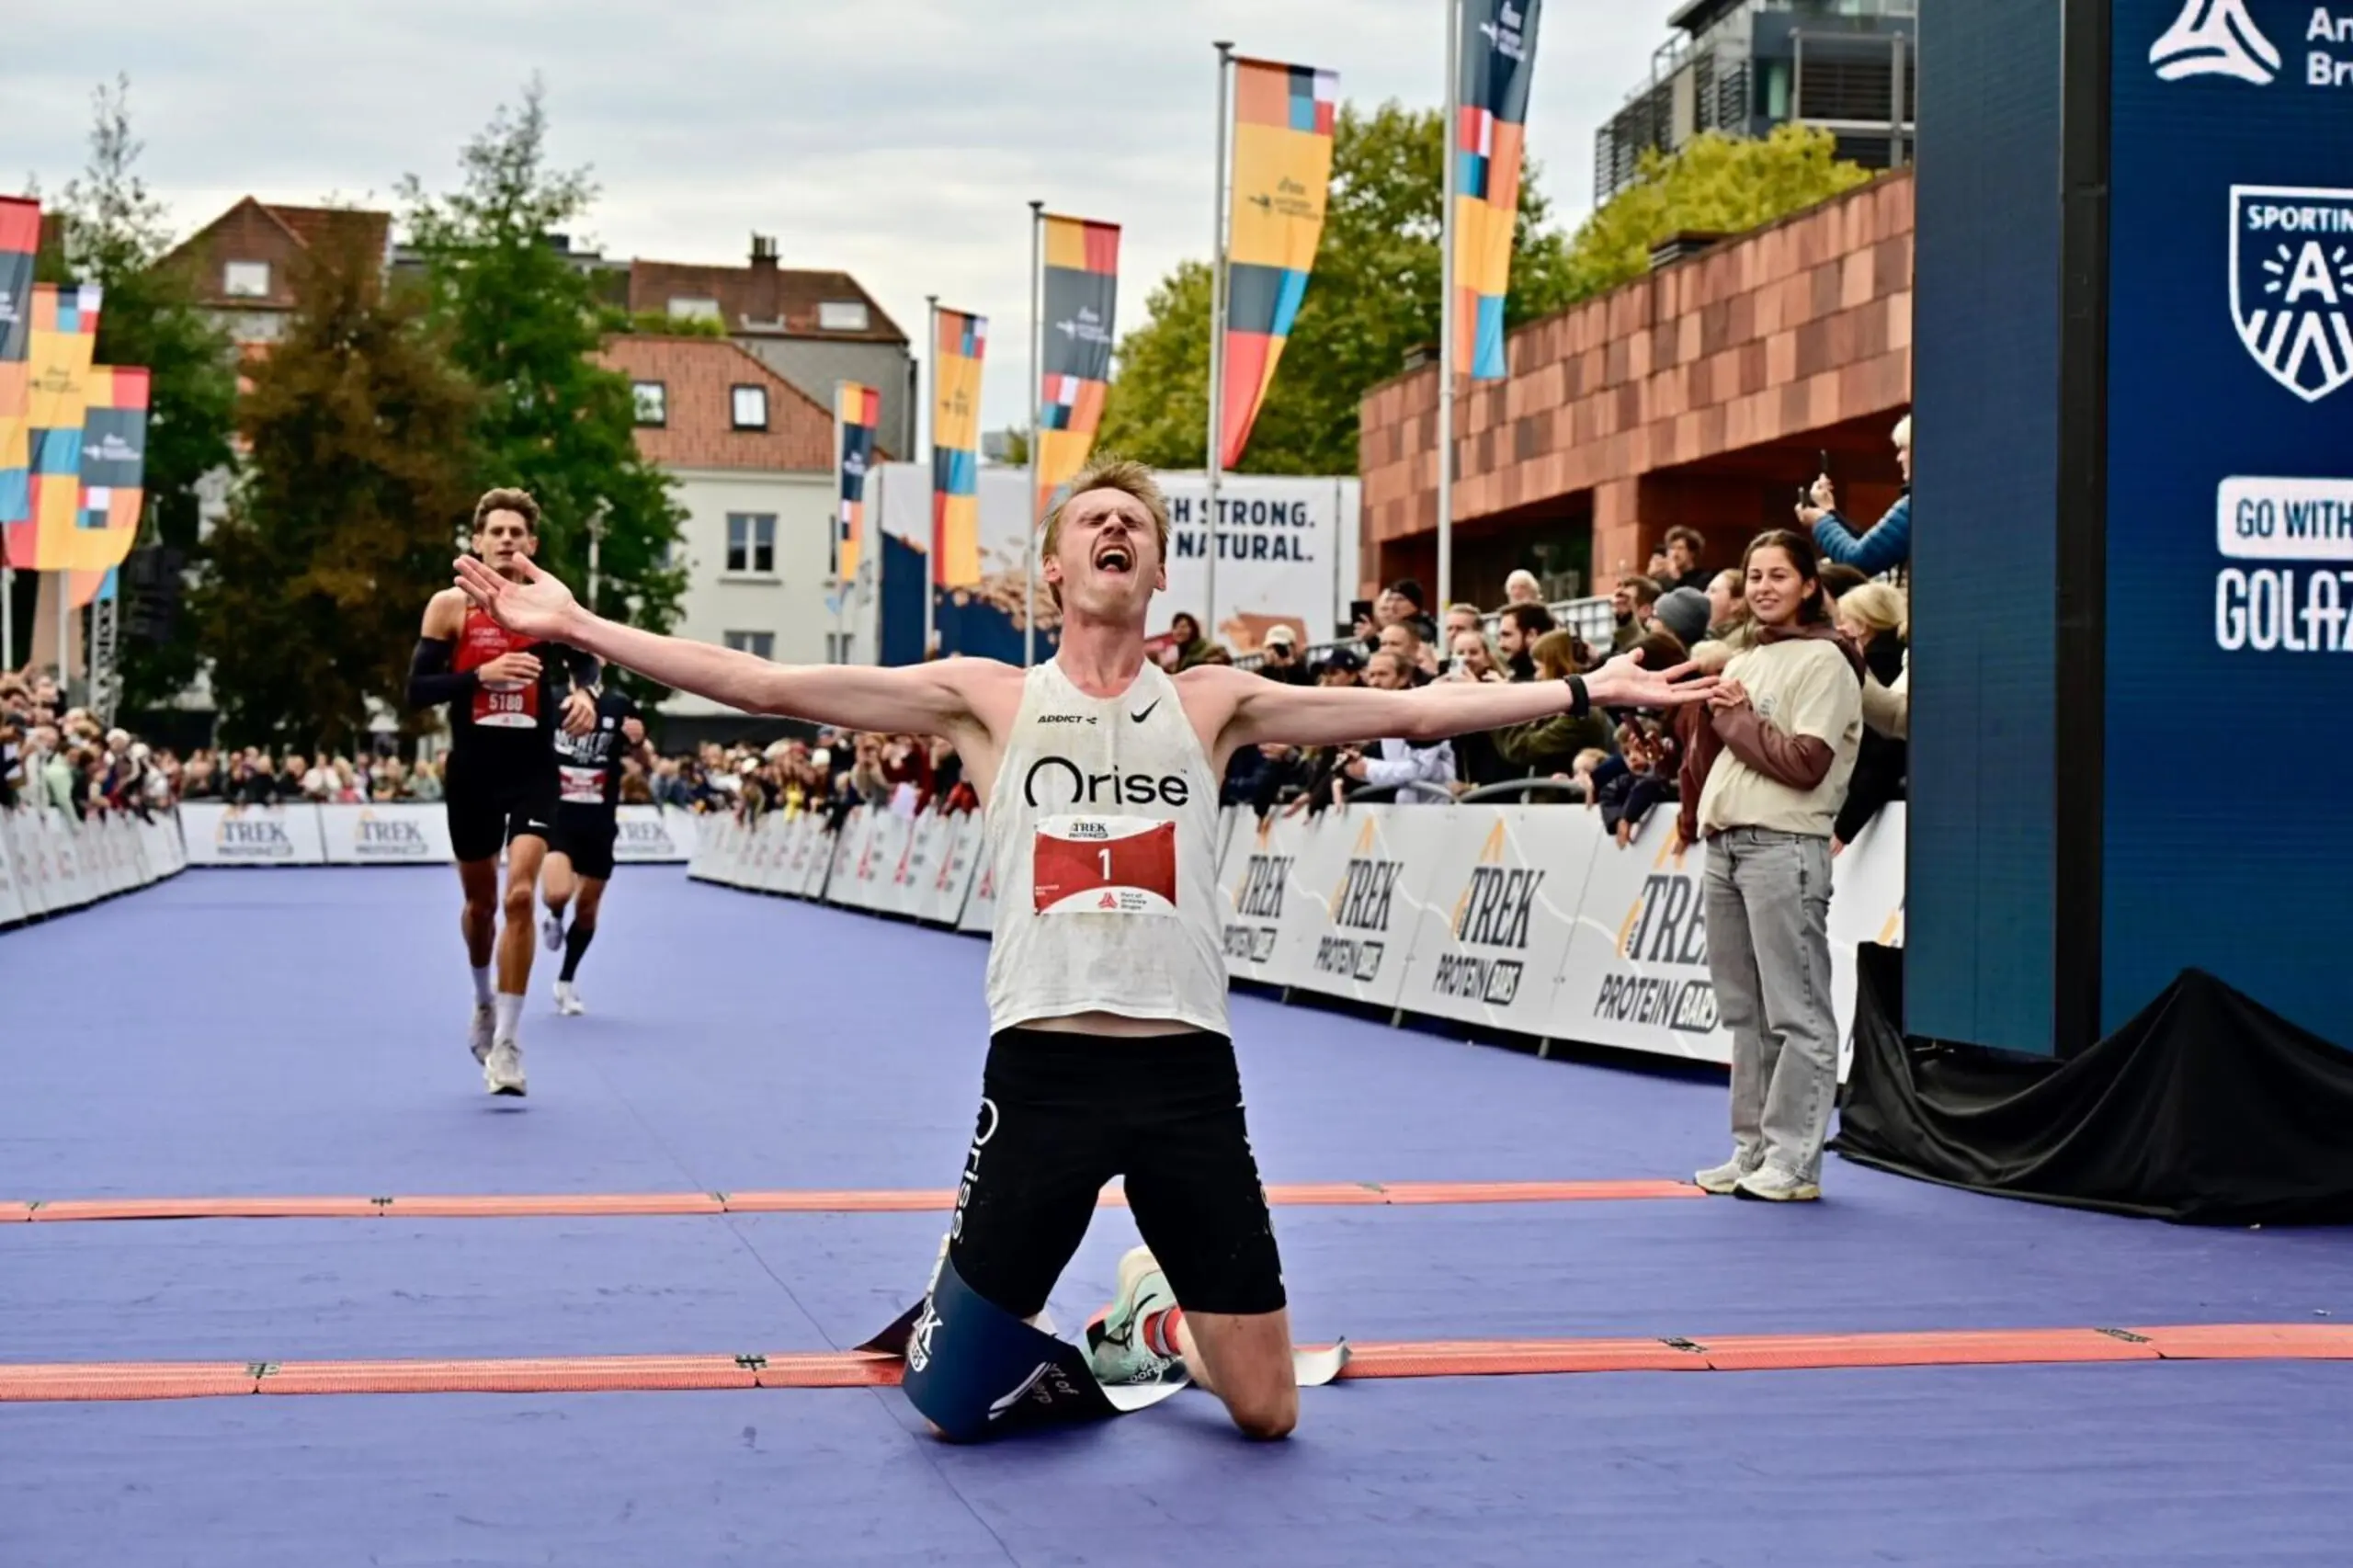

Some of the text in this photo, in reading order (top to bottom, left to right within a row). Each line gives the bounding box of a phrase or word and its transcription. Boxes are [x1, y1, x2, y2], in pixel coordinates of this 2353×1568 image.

[2307, 51, 2353, 86] Br
[2247, 204, 2353, 233] SPORTIN
[2236, 498, 2353, 540] GO WITH
[1037, 715, 1083, 724] ADDICT
[1072, 822, 1107, 832] TREK
[1097, 847, 1111, 881] 1
[1237, 855, 1295, 919] TREK
[1336, 858, 1404, 932] TREK
[1460, 867, 1546, 949] TREK
[1630, 874, 1709, 966] TRE
[1432, 953, 1493, 1002] PROTEIN
[1593, 973, 1678, 1027] PROTEIN
